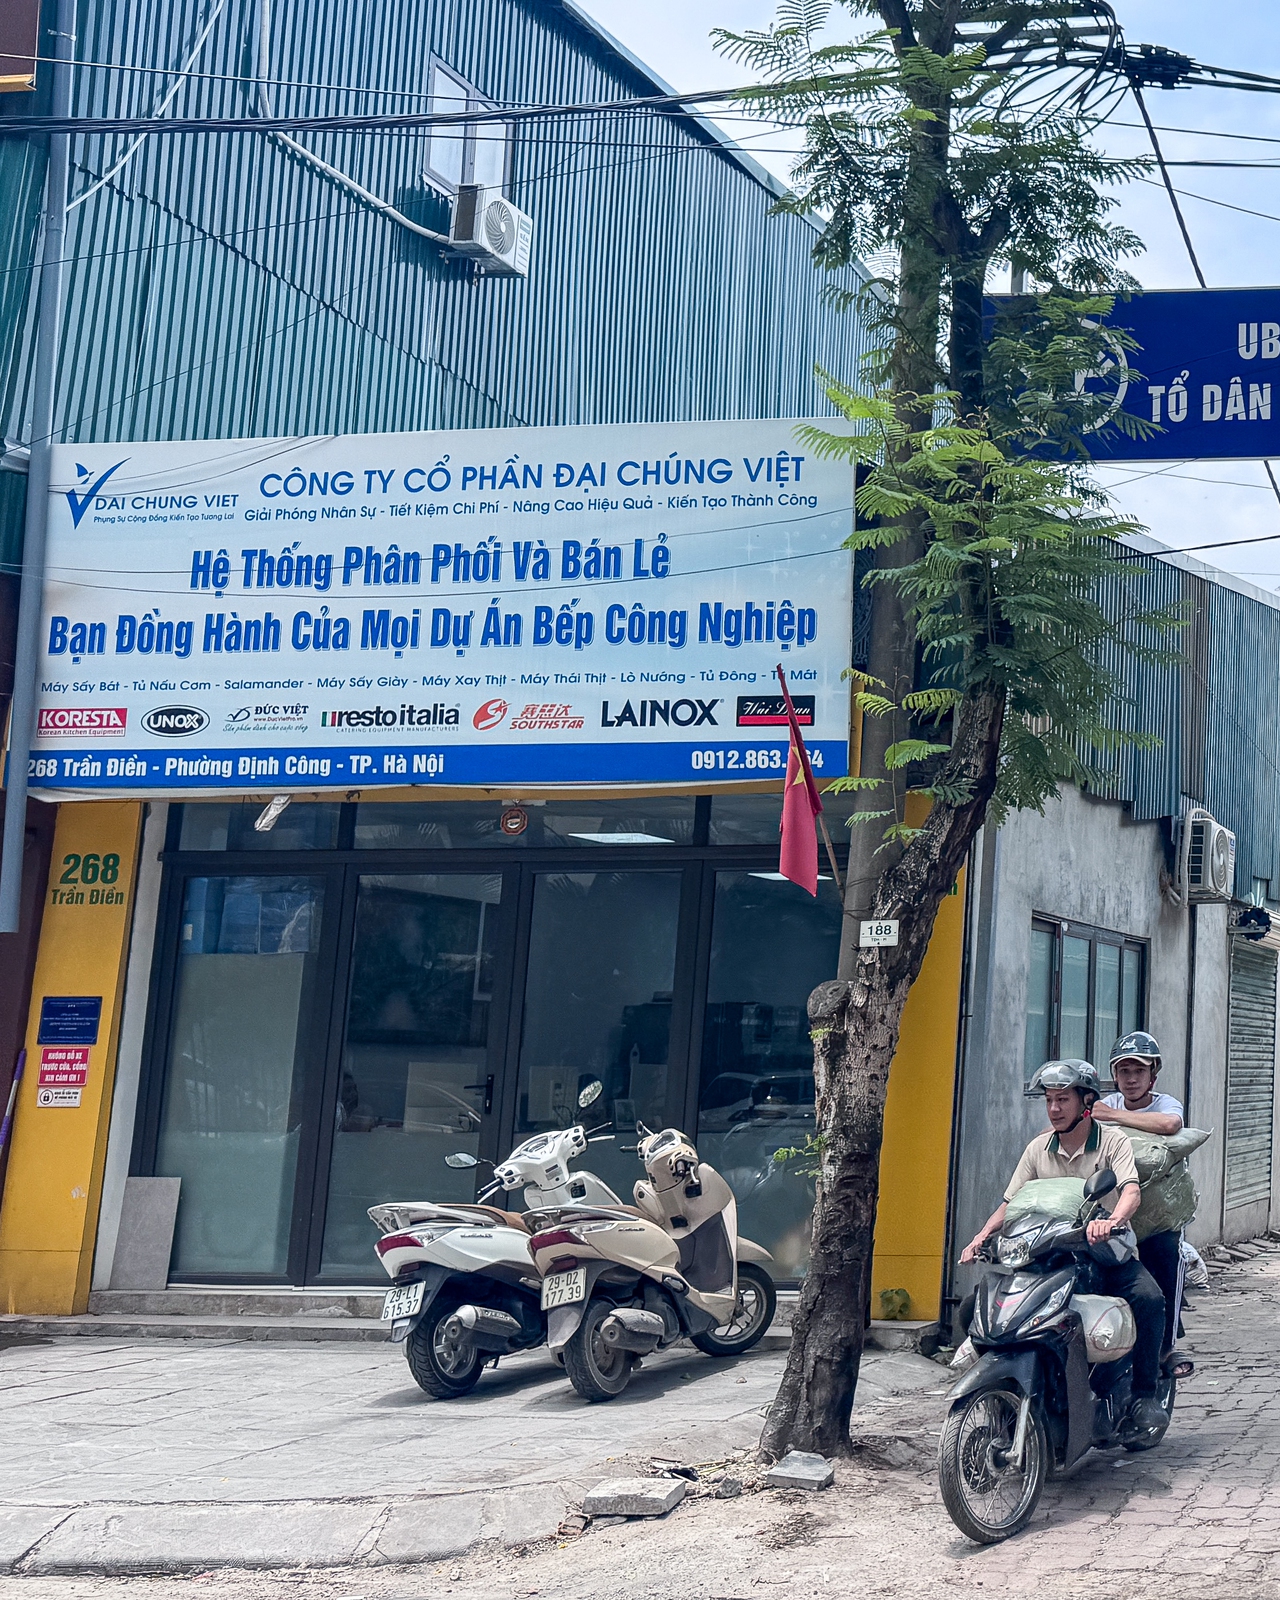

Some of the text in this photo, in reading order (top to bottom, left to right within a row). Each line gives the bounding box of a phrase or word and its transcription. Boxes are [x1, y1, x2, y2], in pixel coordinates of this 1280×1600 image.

[1148, 369, 1189, 423] TỔ
[1202, 376, 1272, 421] DÂN
[259, 451, 806, 498] CÔNG TY CỔ PHẦN ĐẠI CHÚNG VIỆT
[95, 494, 239, 510] DAI CHUNG VIET
[244, 492, 818, 524] Giải Phóng Nhân Sự Tiết Kiệm Chi Phí Nâng Cao Hiệu Quả Kiến Tạo Thành Công
[190, 532, 672, 598] Hệ Thống Phân Phối Và Bán Lẻ
[48, 597, 818, 664] Bạn Đồng Hành Của Mọi Dự Án Bếp Công Nghiệp
[41, 669, 817, 694] Máy Sấy Bát Tủ Nấu Cơm Salamander Máy Sấy Giày Máy Xay Thịt Máy Thái Thịt Lò Nướng Tủ Đông Mát
[41, 710, 123, 727] KORESTA
[254, 702, 309, 717] ĐỨC VIỆT
[601, 698, 720, 727] LAINOX
[149, 714, 200, 729] UNOX
[509, 719, 585, 730] SOUTHSTAR
[27, 752, 444, 780] 268 Trần Điền Phường Định Công TP. Hà Nội
[691, 749, 824, 769] 0912.863.4
[59, 852, 121, 885] 268
[51, 885, 125, 905] Trần Điền
[867, 925, 892, 935] 188
[545, 1286, 583, 1307] 177.39
